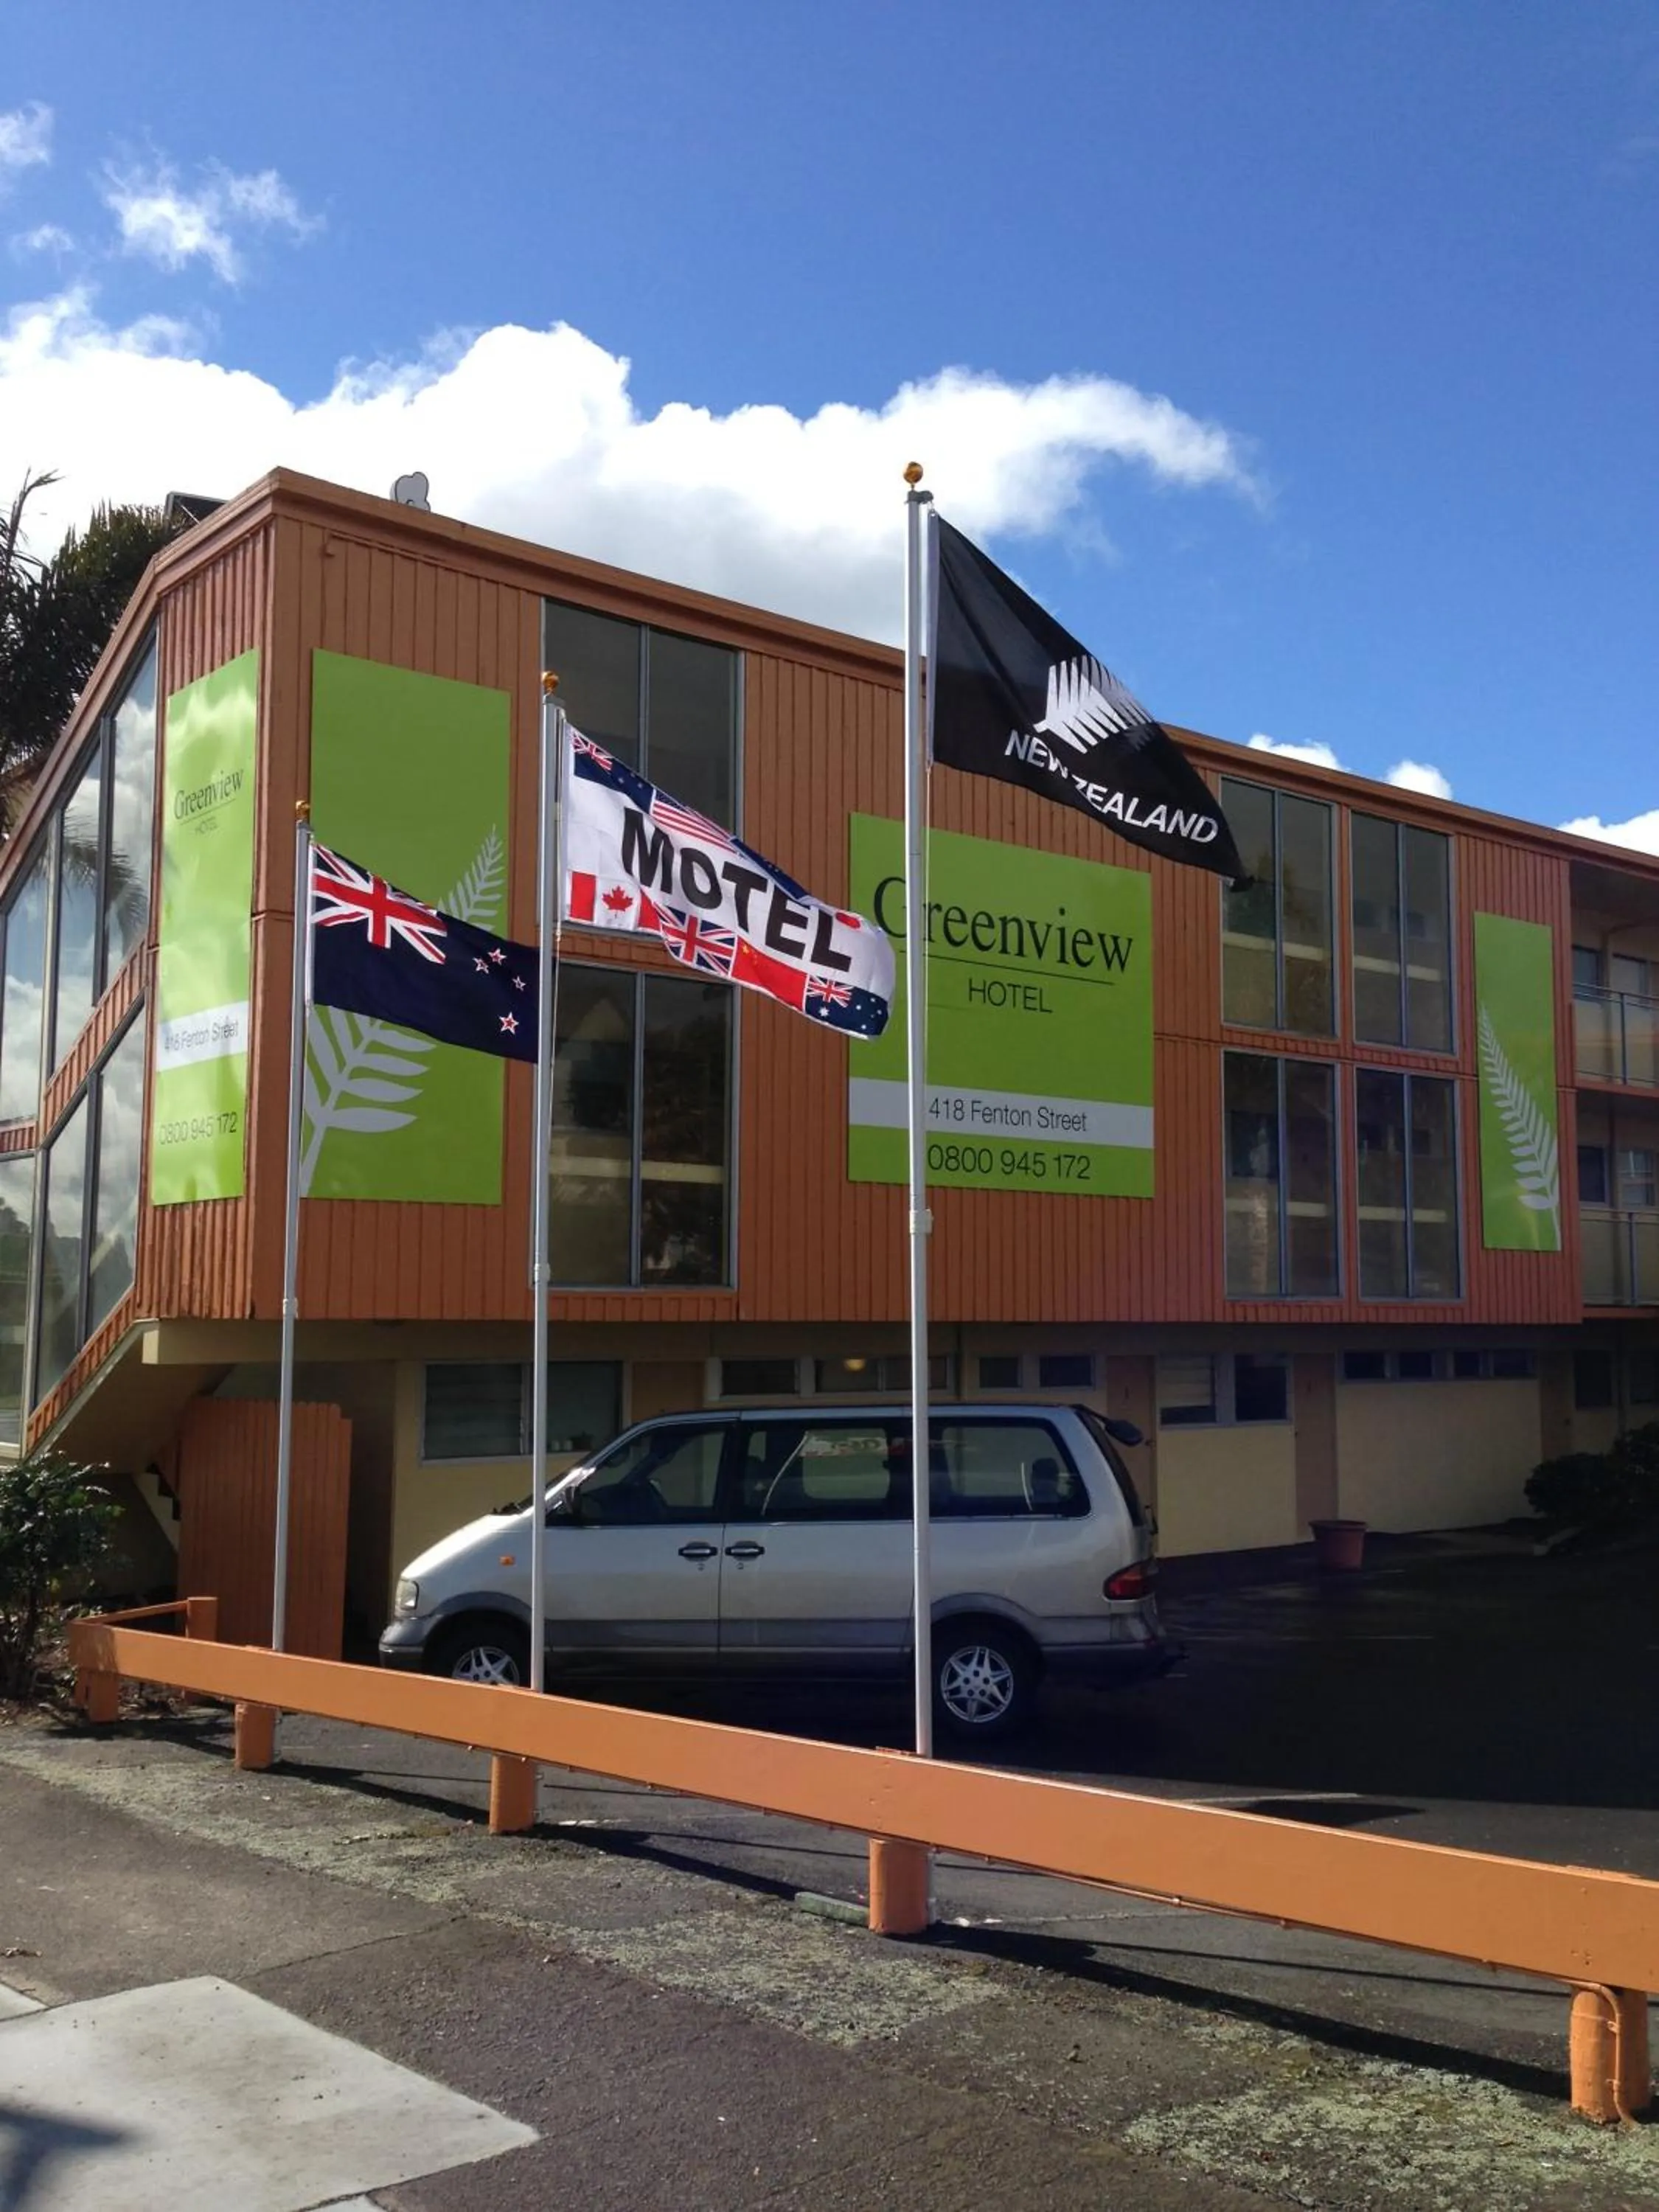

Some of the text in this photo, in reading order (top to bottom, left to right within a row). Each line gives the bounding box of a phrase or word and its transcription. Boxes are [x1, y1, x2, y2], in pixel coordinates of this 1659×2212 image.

[174, 768, 244, 820] Greenview
[1004, 729, 1219, 844] NEW ZEALAND
[622, 807, 852, 973] MOTEL
[969, 978, 1053, 1013] HOTEL
[217, 1111, 238, 1133] 172
[929, 1097, 1088, 1132] 418 Fenton Street
[928, 1144, 1091, 1180] 0800 945 172
